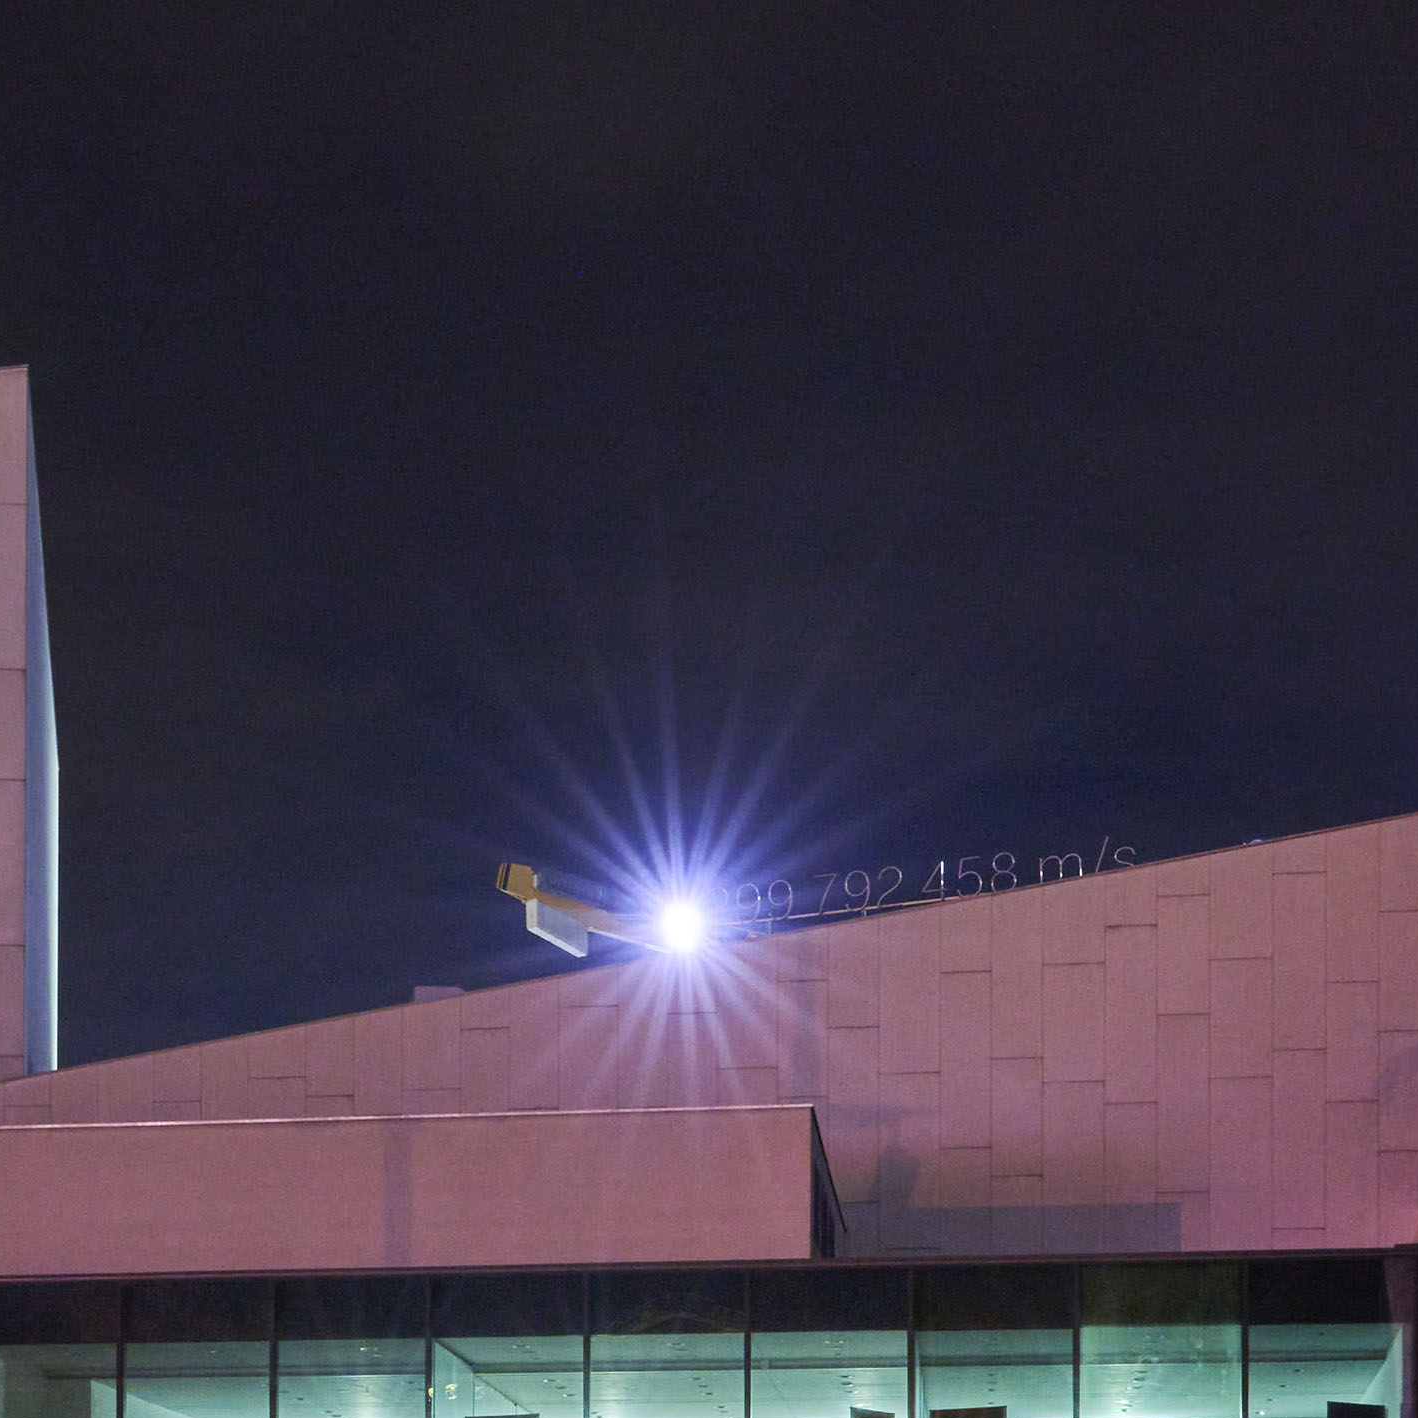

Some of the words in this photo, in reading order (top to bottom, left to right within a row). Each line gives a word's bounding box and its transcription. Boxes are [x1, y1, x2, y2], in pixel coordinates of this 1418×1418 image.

[814, 865, 903, 915] 792
[921, 852, 1018, 901] 458
[1038, 835, 1136, 884] m/s
